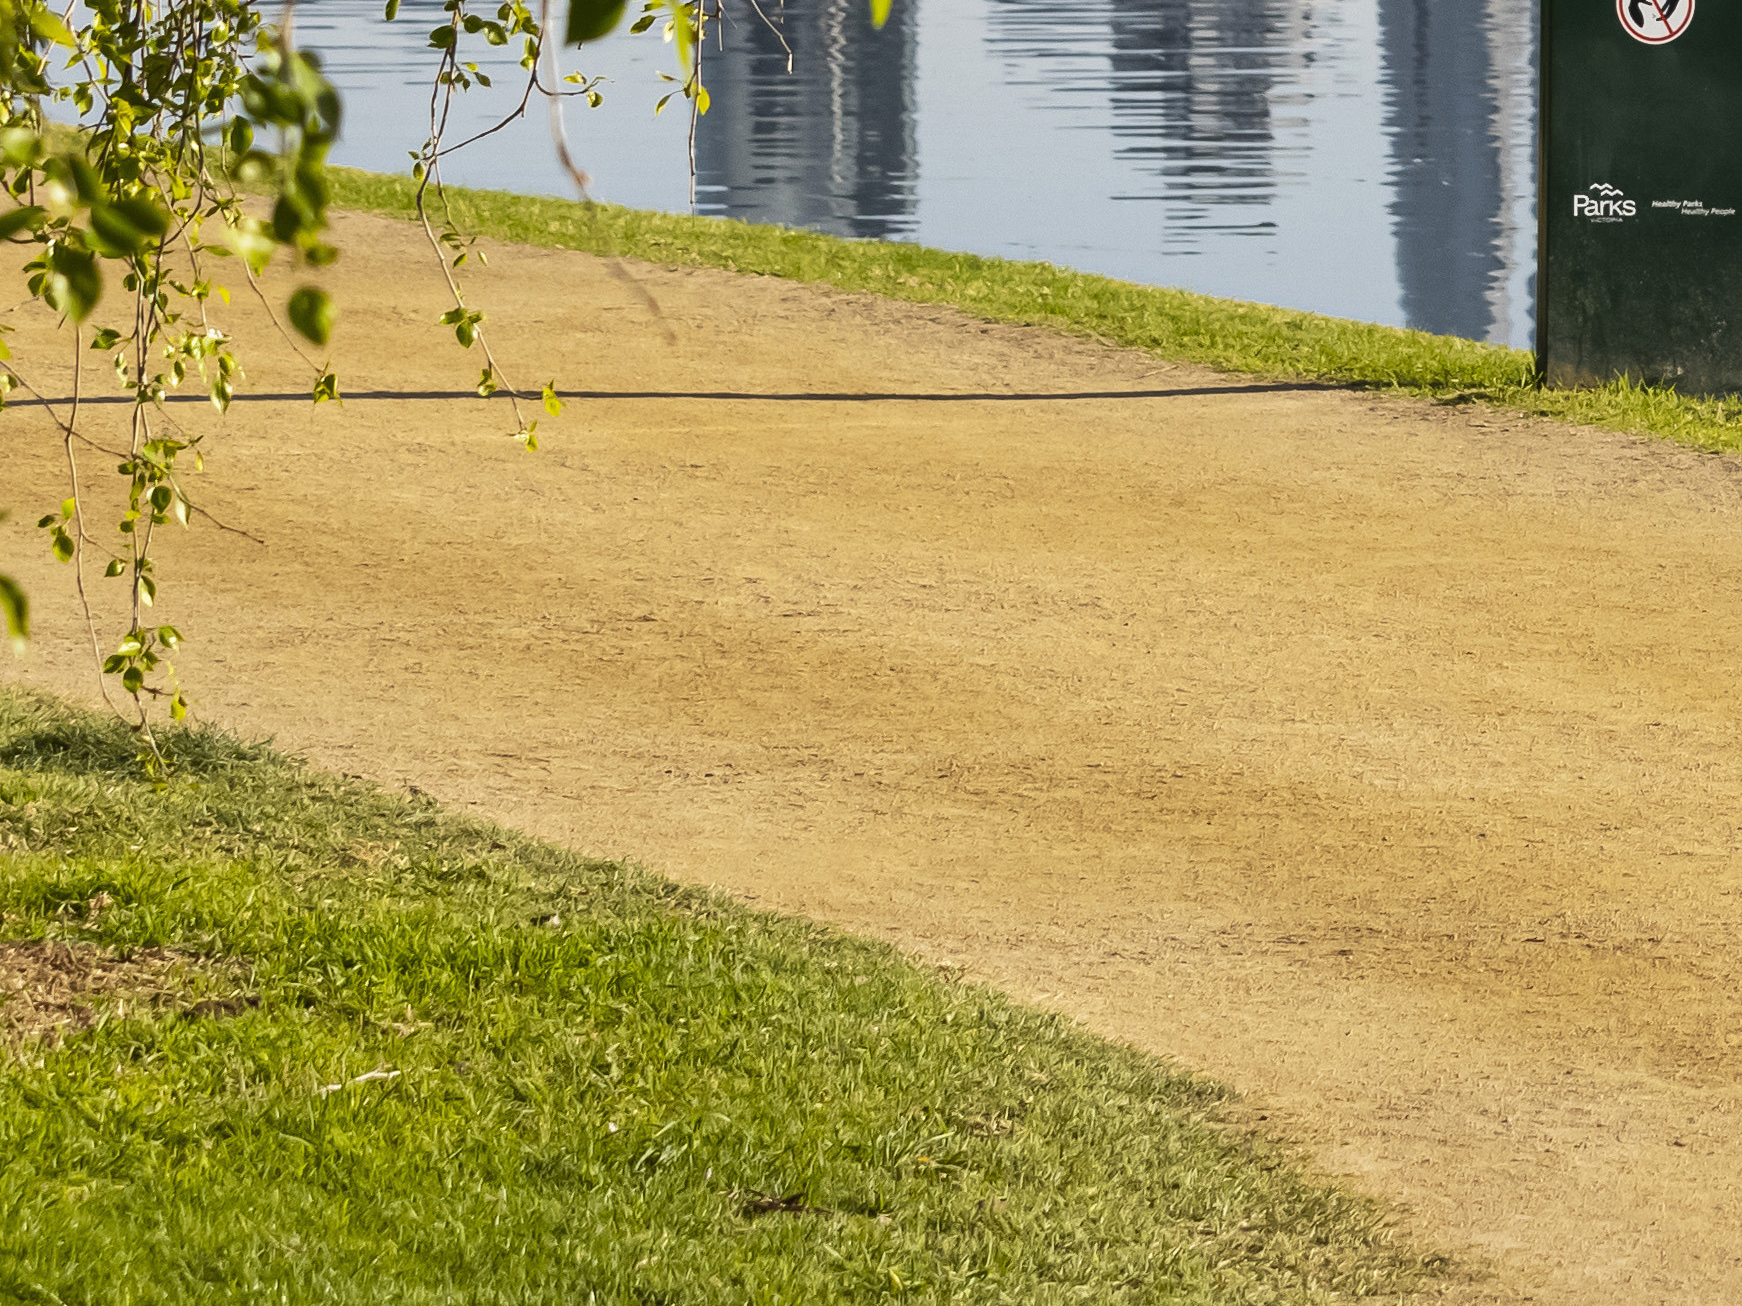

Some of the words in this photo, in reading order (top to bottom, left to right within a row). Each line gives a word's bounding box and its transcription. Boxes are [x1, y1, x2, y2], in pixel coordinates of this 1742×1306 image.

[1573, 194, 1637, 217] Parks
[1651, 200, 1682, 209] Healthy
[1710, 207, 1736, 216] People
